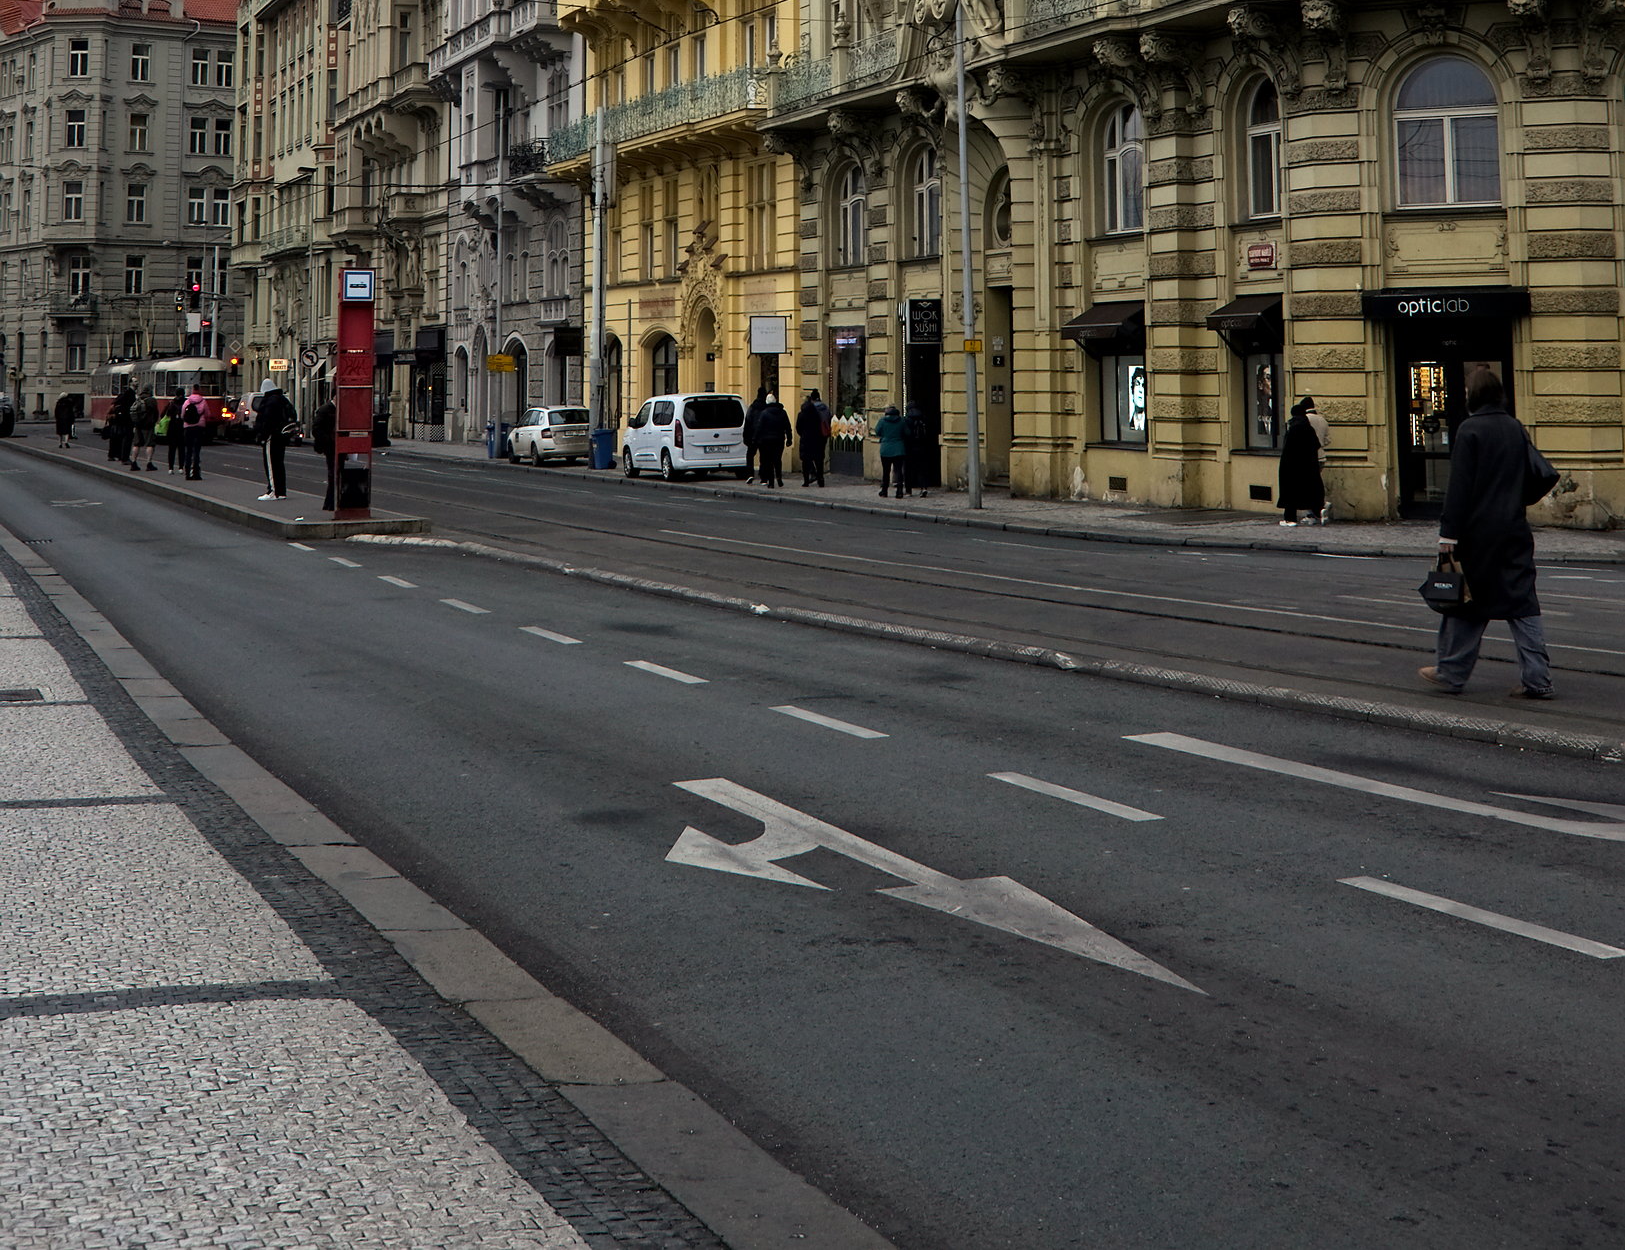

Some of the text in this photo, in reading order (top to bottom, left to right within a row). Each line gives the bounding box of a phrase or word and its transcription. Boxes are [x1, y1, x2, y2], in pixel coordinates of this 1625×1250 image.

[1398, 298, 1470, 317] opticlab
[912, 310, 938, 320] WOK
[914, 323, 938, 333] SUSHI
[1221, 319, 1242, 328] optic
